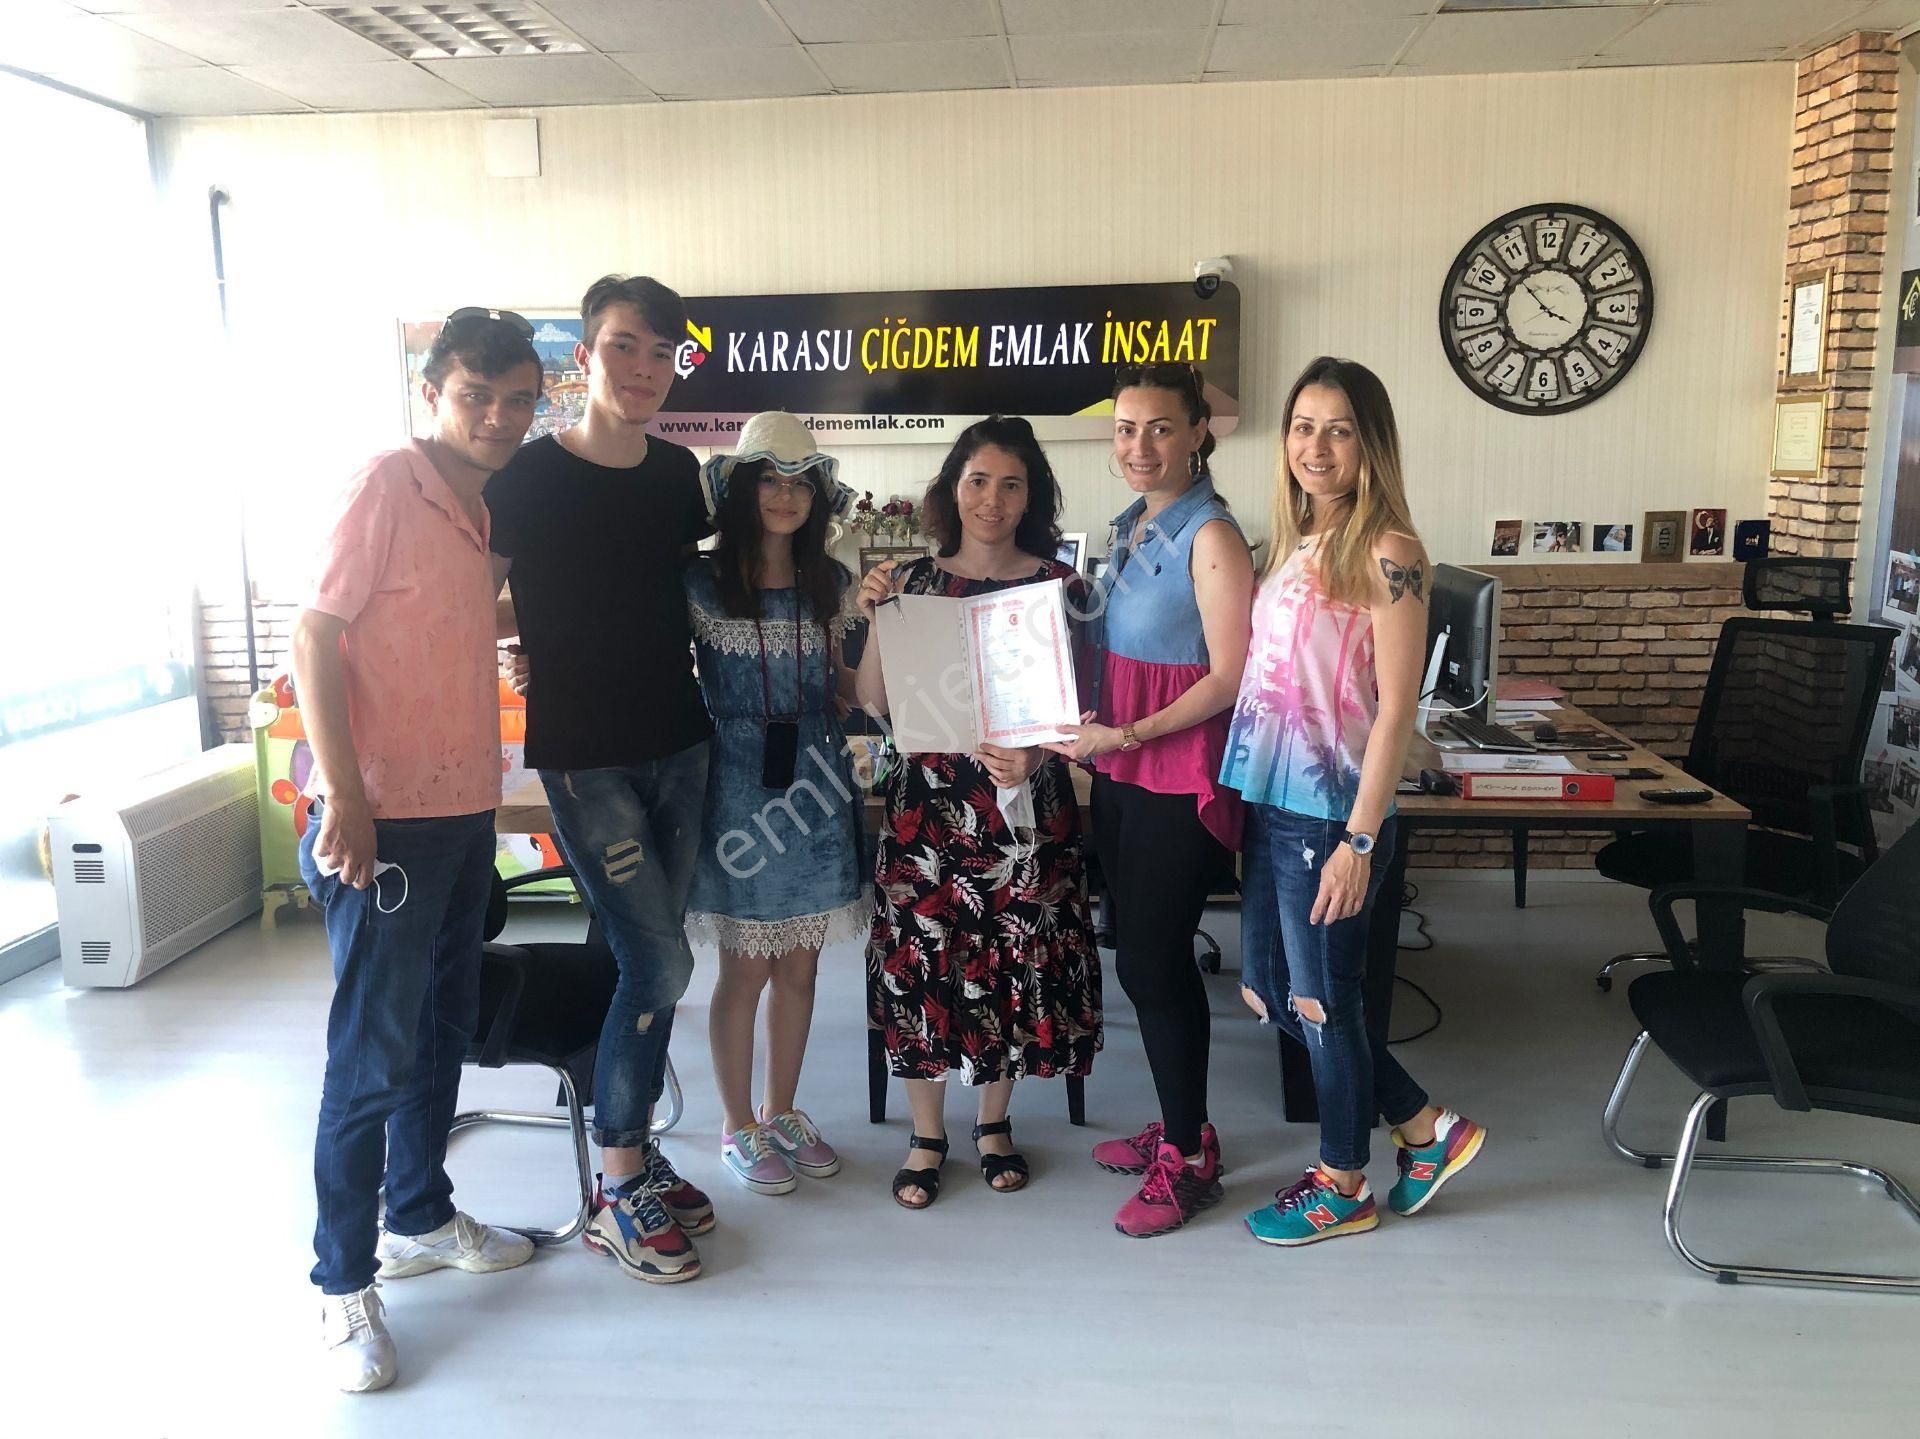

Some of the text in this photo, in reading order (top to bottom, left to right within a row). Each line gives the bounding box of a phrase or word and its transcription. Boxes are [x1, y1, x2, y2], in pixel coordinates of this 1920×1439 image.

[1541, 232, 1556, 248] 12
[1505, 243, 1522, 260] 11
[1579, 241, 1590, 255] 1
[1478, 269, 1496, 285] 10
[1600, 267, 1618, 281] 2
[1468, 307, 1485, 317] 9
[1609, 304, 1625, 313] 3
[727, 329, 853, 373] KARASU
[861, 316, 979, 375] ÇİĞDEM
[988, 322, 1094, 367] EMLAK
[1477, 340, 1493, 353] 8
[1597, 338, 1613, 350] 4
[1502, 364, 1516, 378] 7
[1572, 362, 1585, 377] 5
[1538, 372, 1548, 387] 6
